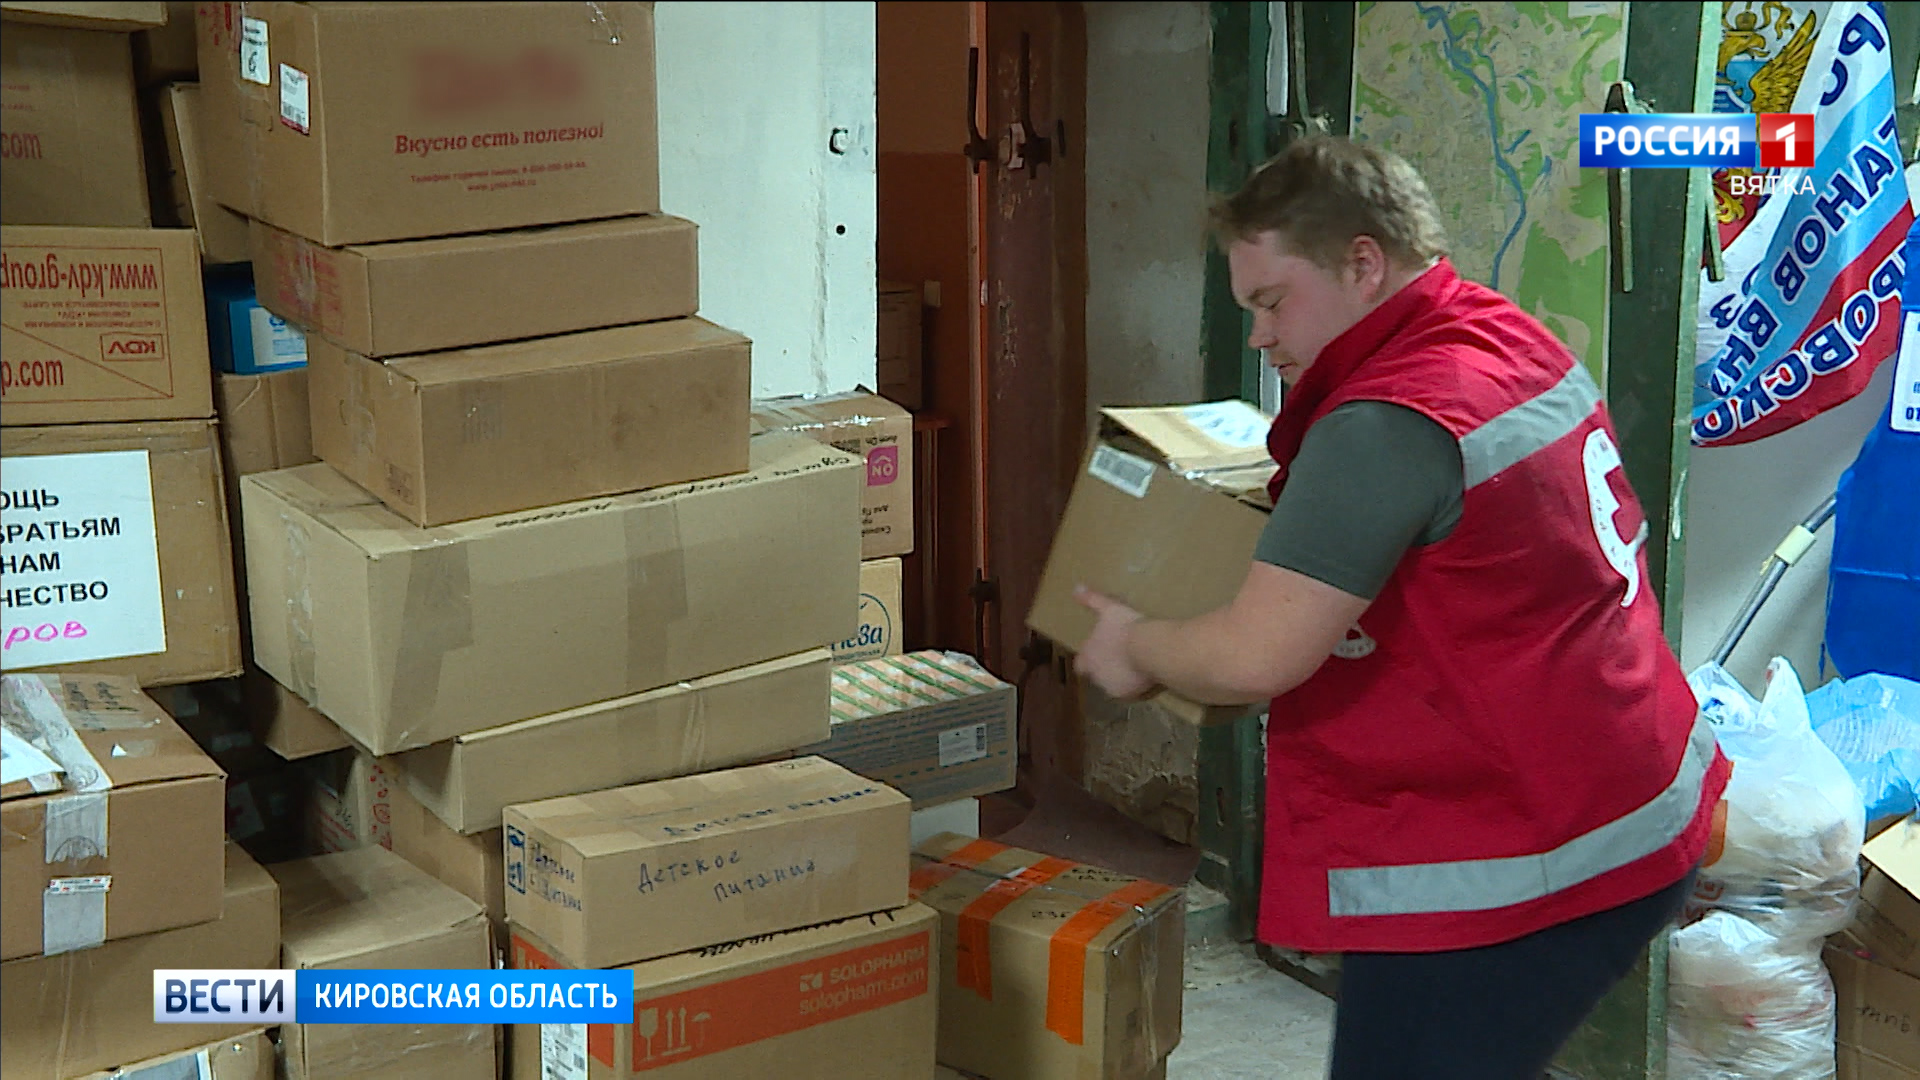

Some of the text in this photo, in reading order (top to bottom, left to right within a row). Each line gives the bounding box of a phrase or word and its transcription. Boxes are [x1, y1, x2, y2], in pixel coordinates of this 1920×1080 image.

[394, 122, 604, 157] Вкусно есть полезно!
[108, 341, 156, 354] KDV
[1, 621, 87, 650] ров
[638, 850, 741, 895] Детское
[830, 945, 925, 984] SOLOPHARM
[800, 967, 925, 1016] solopharm.com
